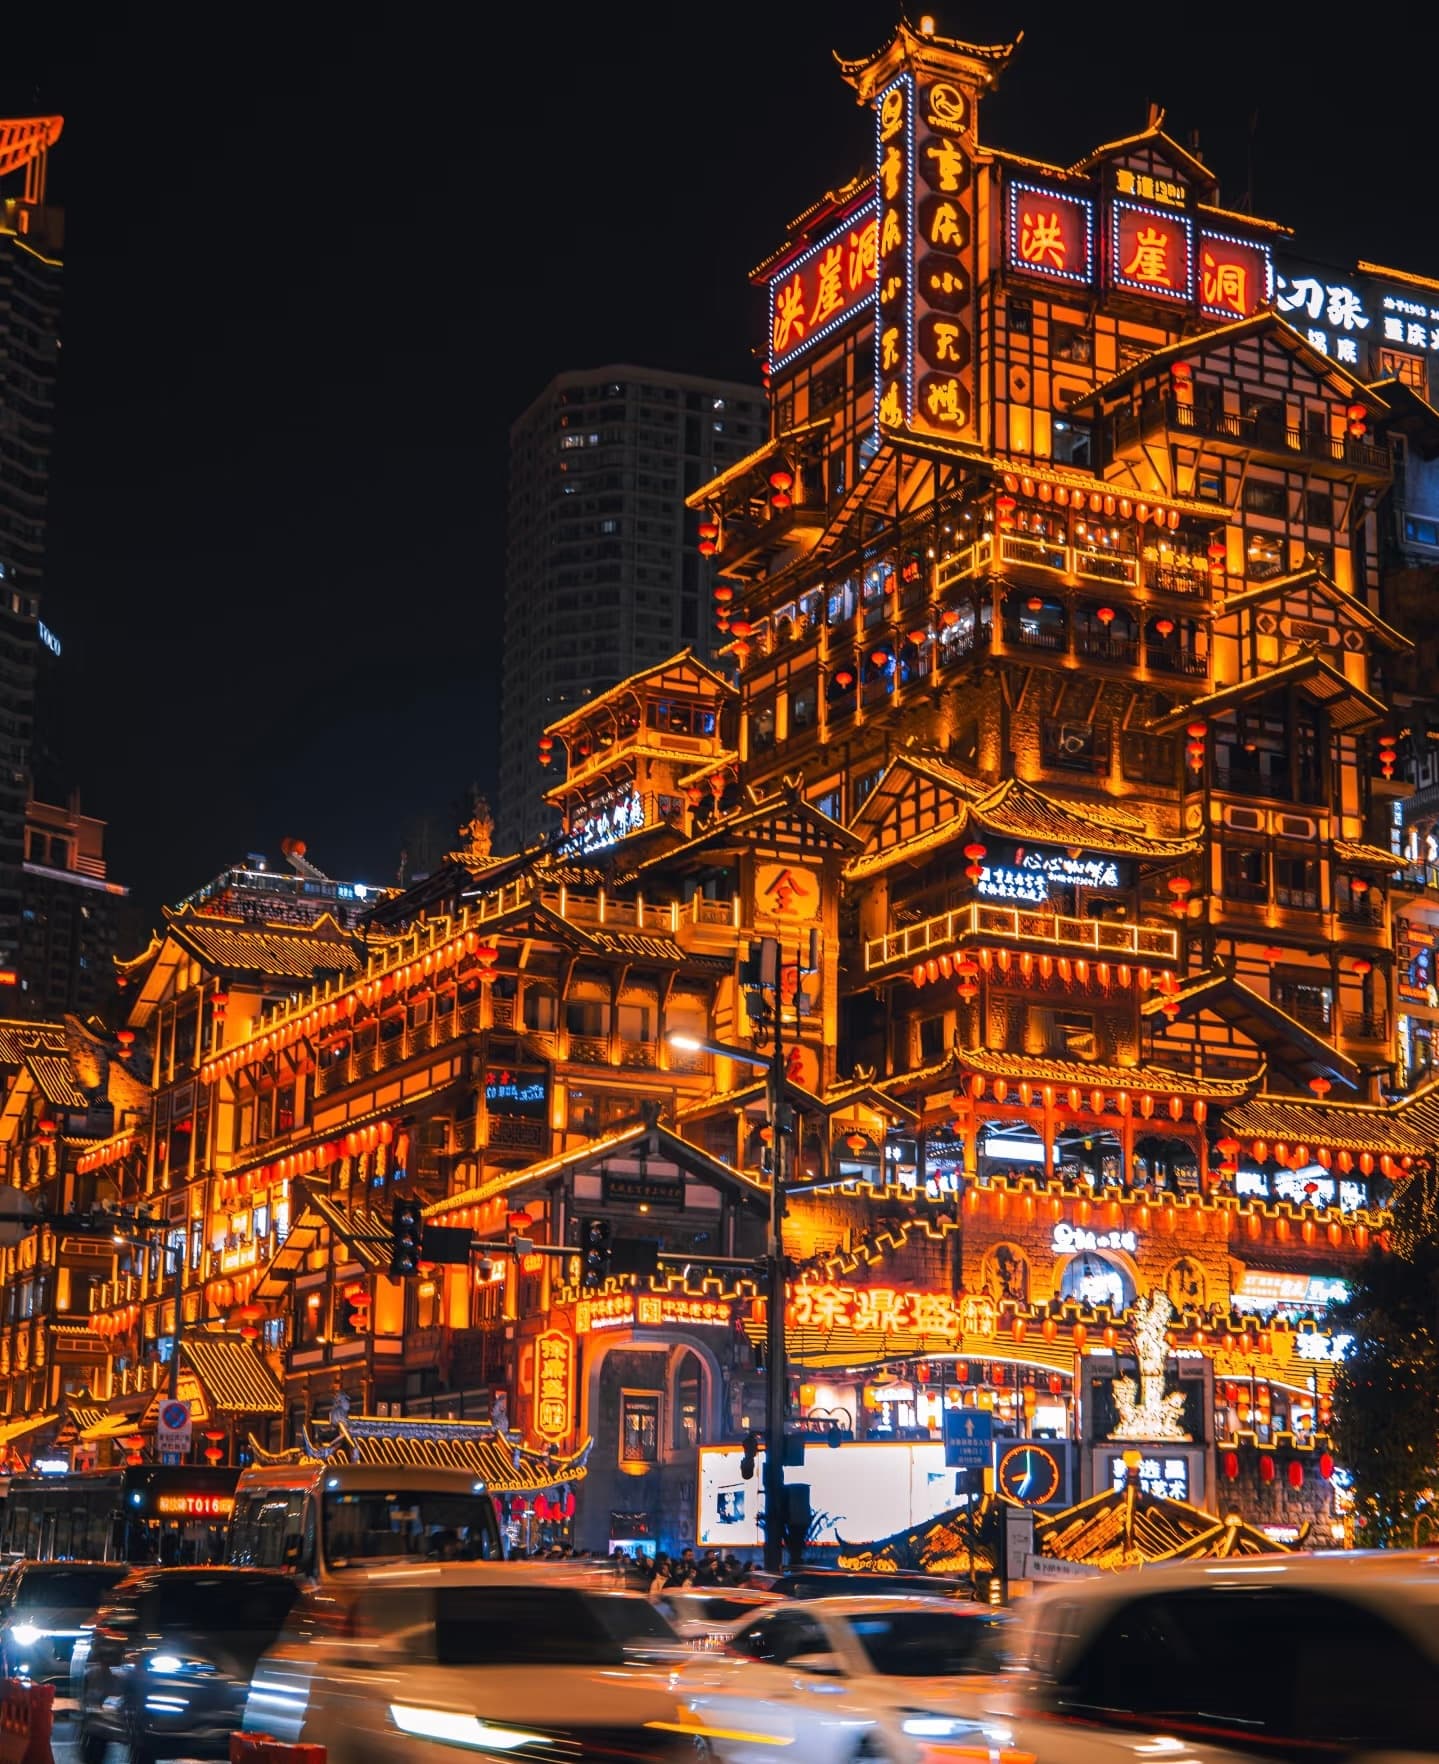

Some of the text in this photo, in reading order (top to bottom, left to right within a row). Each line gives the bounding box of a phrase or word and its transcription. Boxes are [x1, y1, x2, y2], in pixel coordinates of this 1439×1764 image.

[773, 218, 879, 352] 洪崖洞
[1021, 212, 1248, 313] 洪崖洞
